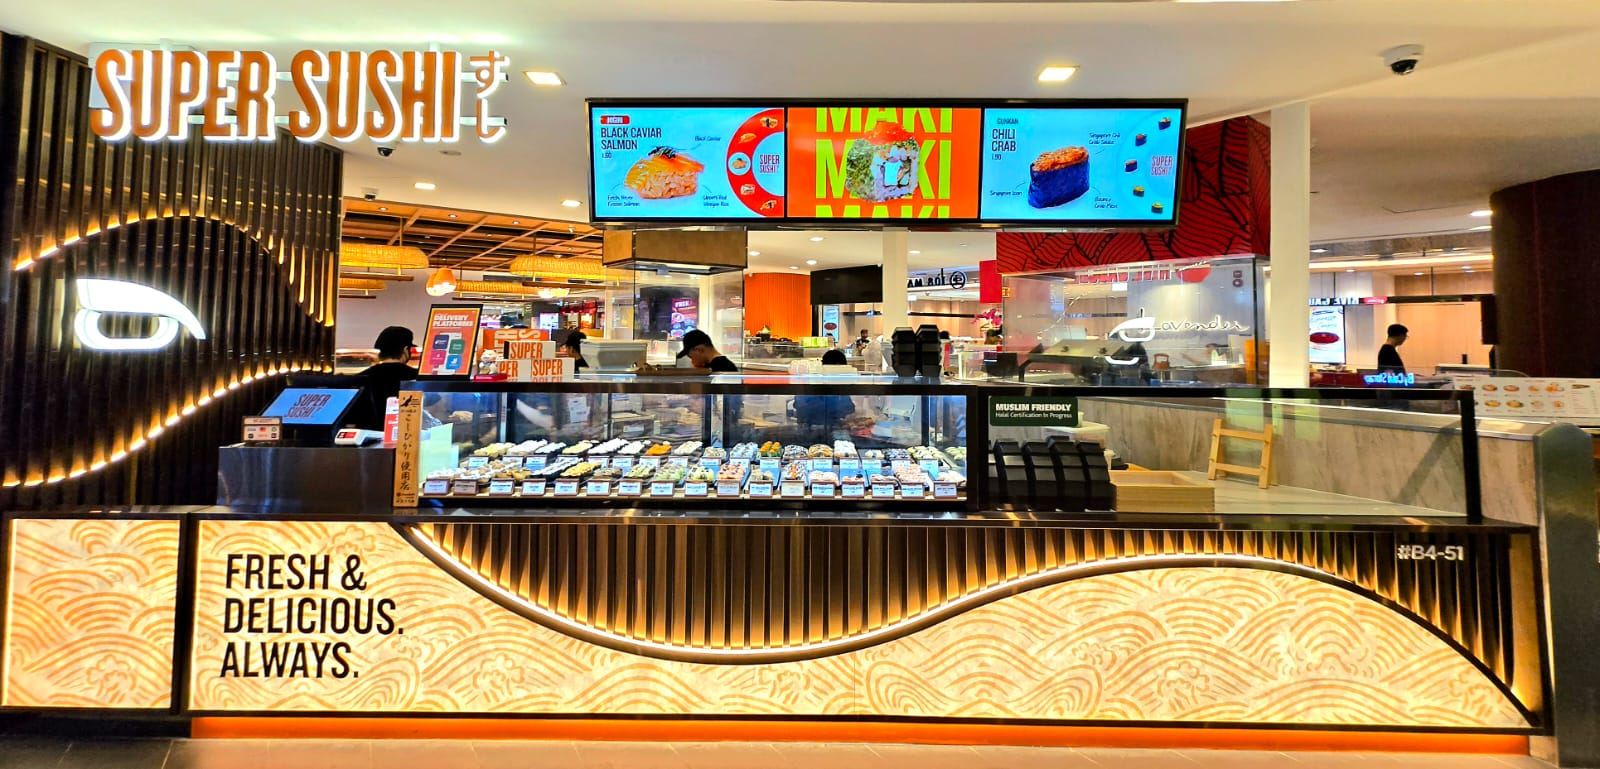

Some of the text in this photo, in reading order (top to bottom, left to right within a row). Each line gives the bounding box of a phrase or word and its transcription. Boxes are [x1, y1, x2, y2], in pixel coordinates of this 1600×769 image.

[90, 49, 460, 141] SUPER SUSHI
[469, 50, 507, 141] すし
[601, 127, 662, 138] BLACK CAVIAR
[992, 128, 1016, 140] CHILI
[601, 139, 638, 150] SALMON
[991, 140, 1017, 151] CRAB
[759, 154, 780, 165] SUPER
[1151, 155, 1173, 166] SUPER
[759, 165, 776, 174] SUSHI
[816, 139, 951, 200] MKI
[510, 342, 543, 360] SUPER
[532, 359, 563, 377] SUPER
[294, 394, 332, 407] SUPER
[995, 403, 1072, 411] MUSLIM FRIENDLY
[1049, 411, 1073, 420] Progress
[1397, 544, 1464, 560] #B4-51
[225, 554, 368, 591] FRESH &
[223, 598, 404, 635] DELICIOUS.
[220, 641, 359, 678] ALWAYS.
